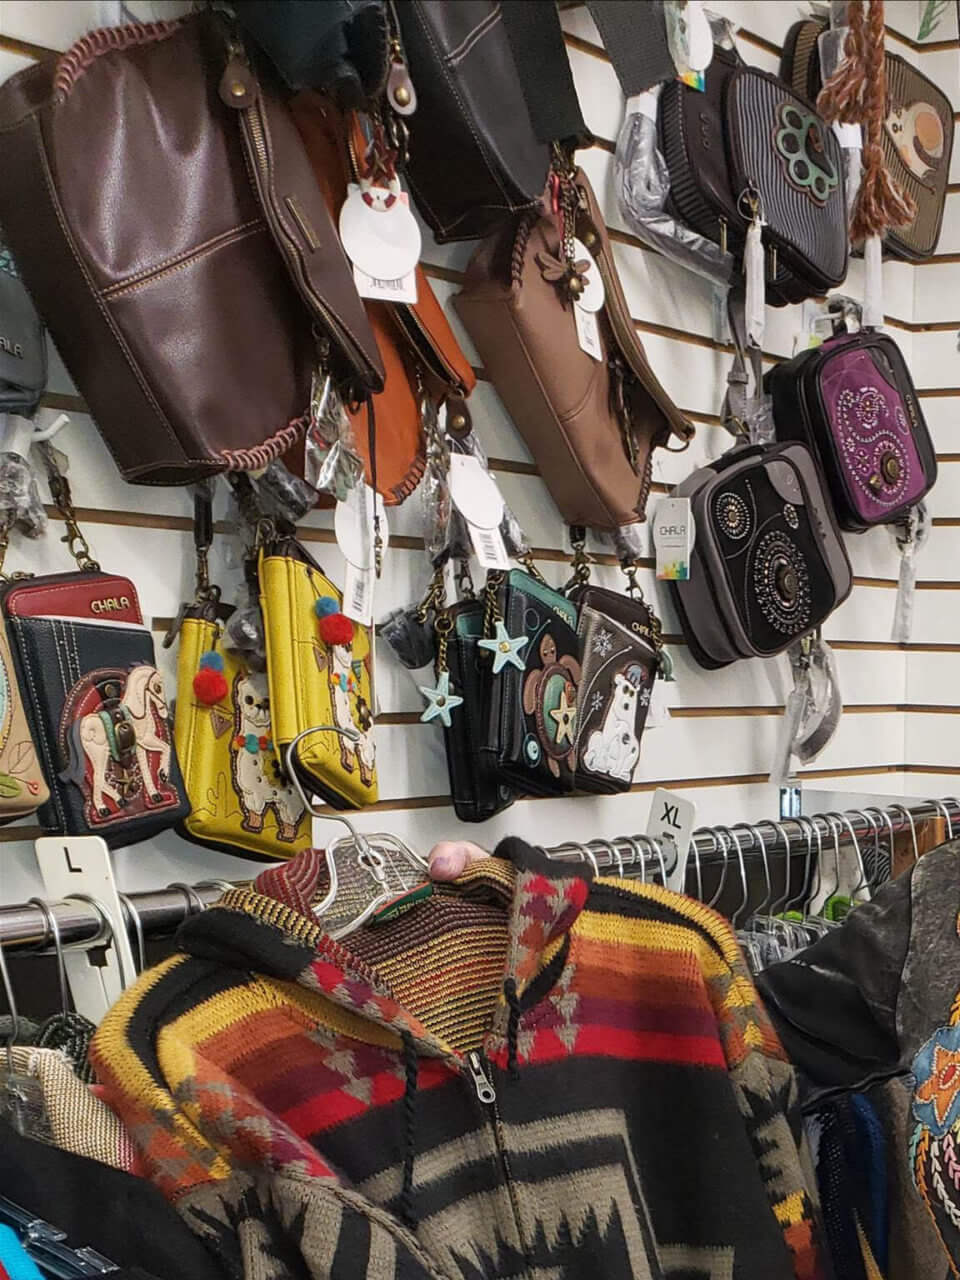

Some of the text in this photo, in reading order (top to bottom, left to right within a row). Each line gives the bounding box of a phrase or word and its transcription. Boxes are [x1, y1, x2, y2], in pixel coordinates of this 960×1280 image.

[659, 525, 687, 536] CHALA
[91, 596, 130, 613] CHALA
[660, 801, 682, 830] XL
[63, 846, 83, 873] L
